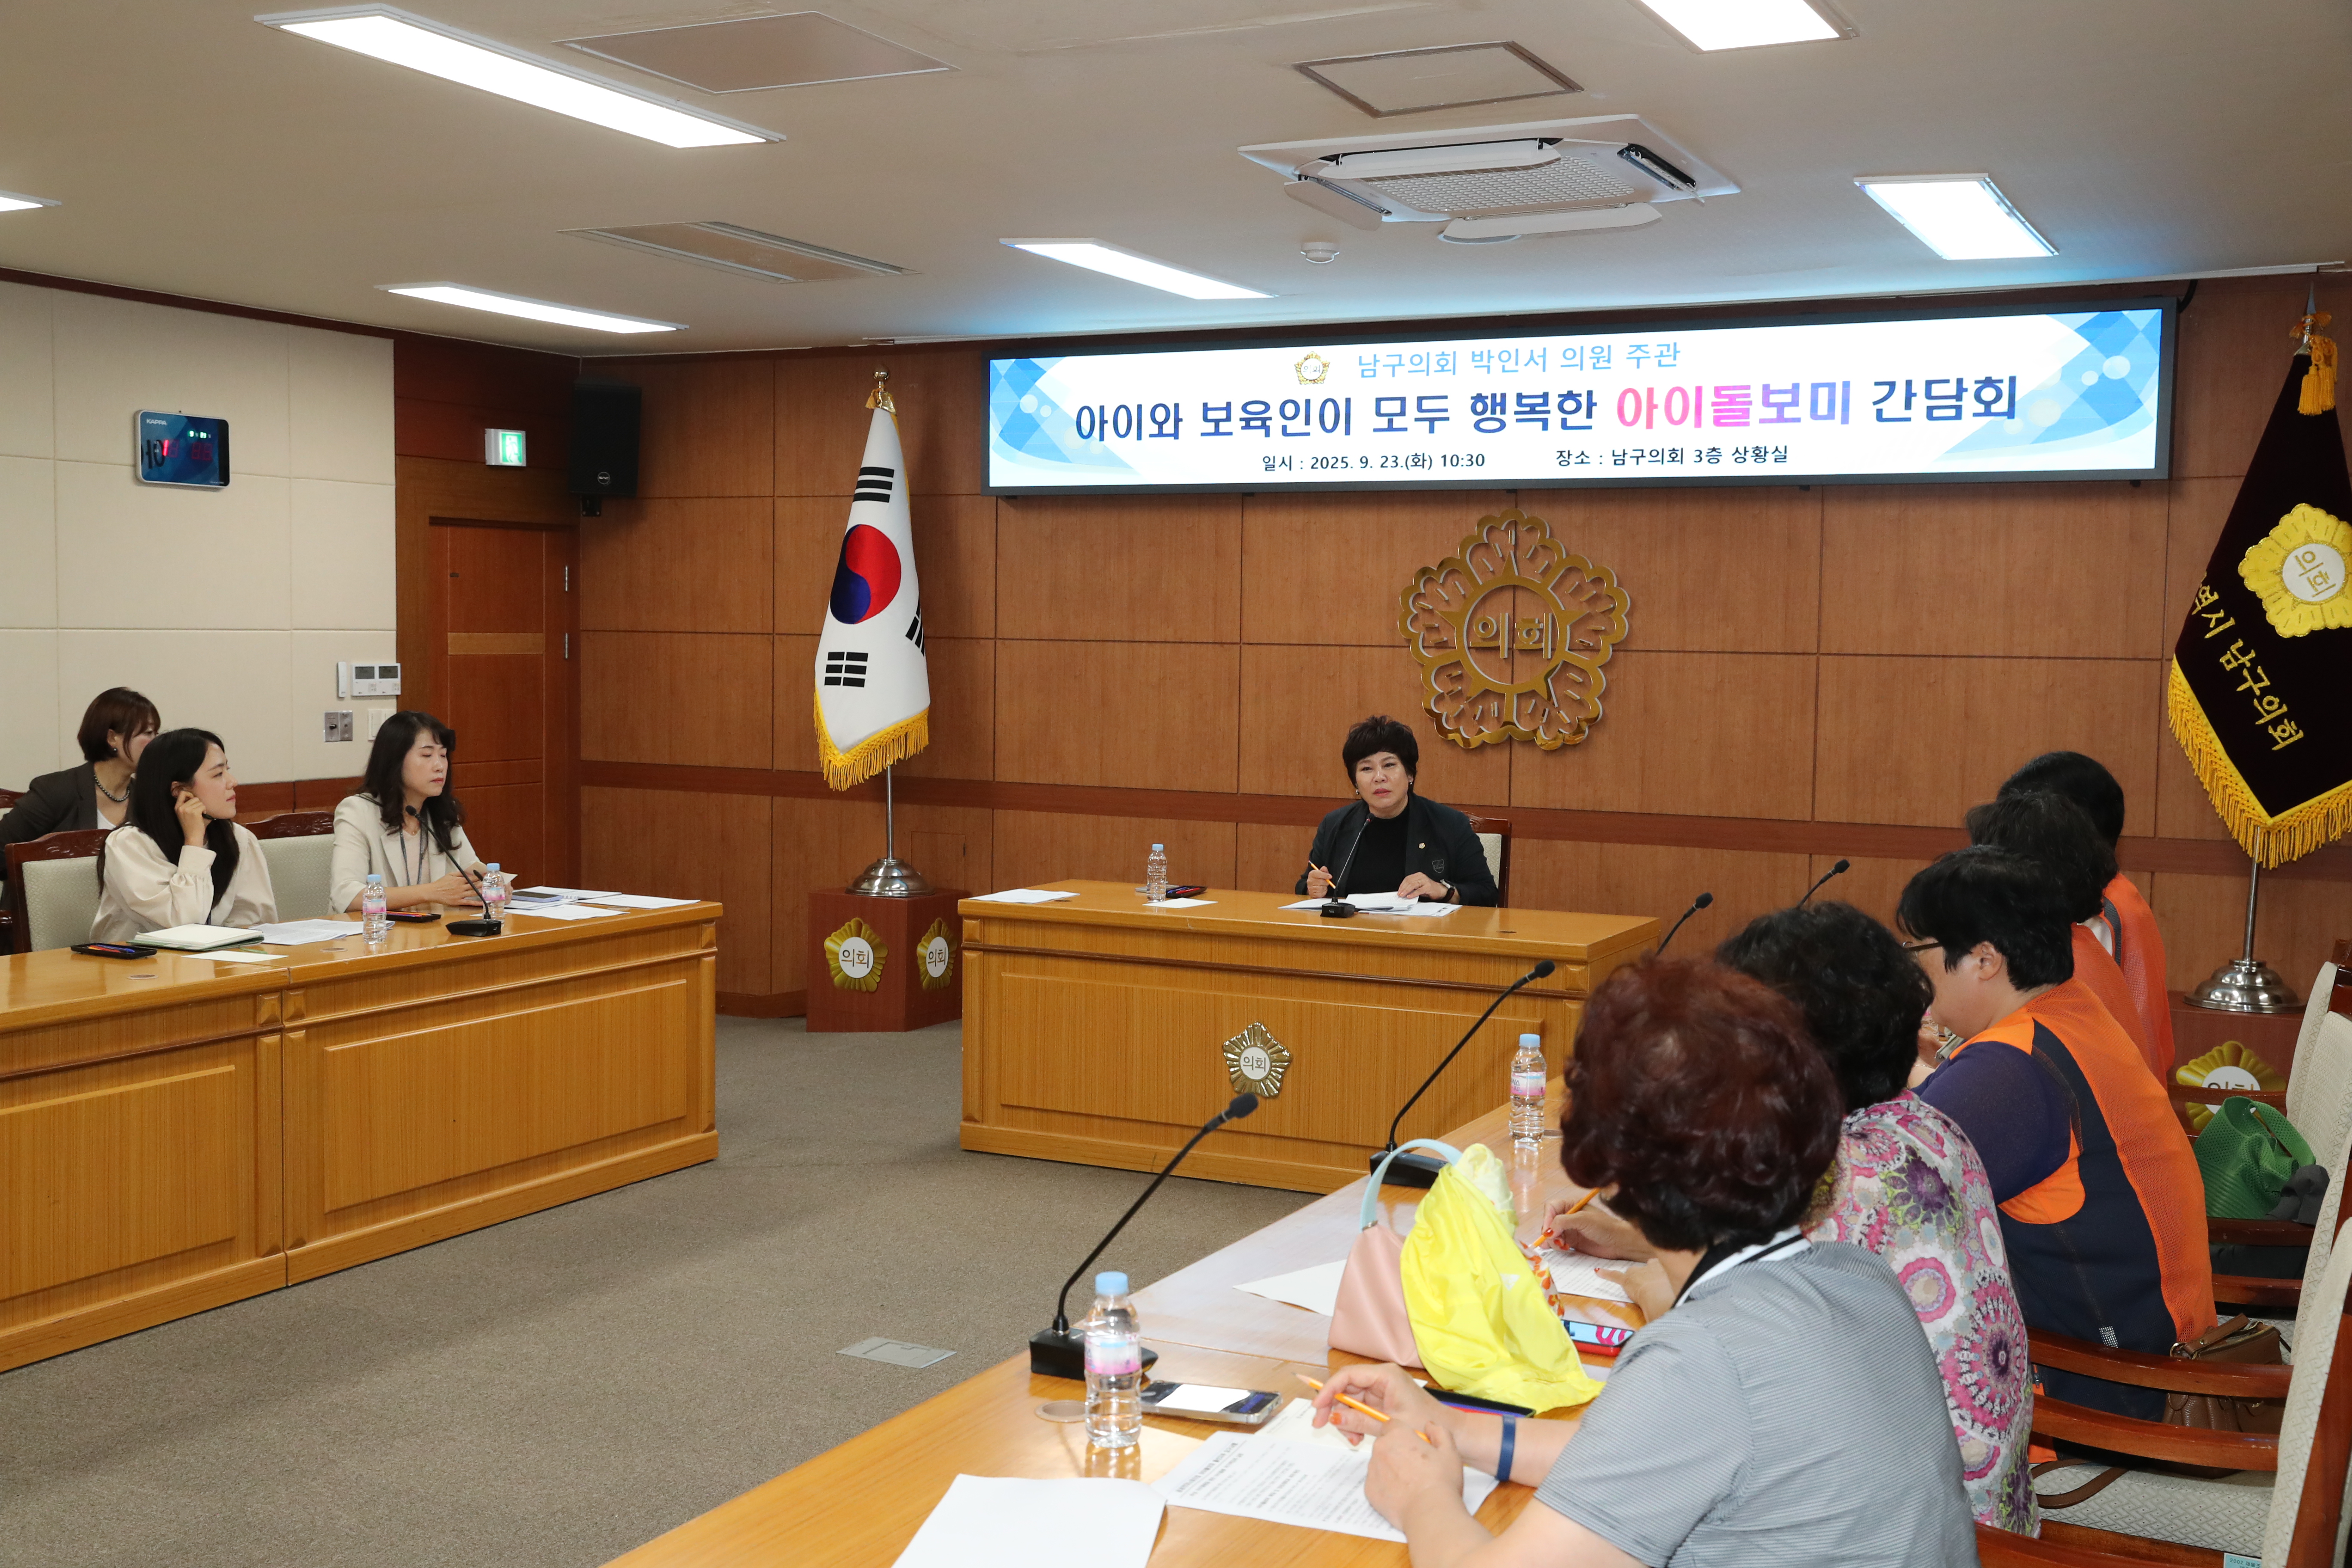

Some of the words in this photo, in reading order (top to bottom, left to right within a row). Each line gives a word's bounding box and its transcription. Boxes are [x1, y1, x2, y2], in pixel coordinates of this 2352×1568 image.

[1359, 351, 1457, 379] 남구의회
[1471, 346, 1547, 375] 박인서
[1560, 344, 1612, 372] 의원
[1626, 342, 1681, 369] 주관
[1075, 402, 1183, 442] 아이와
[1200, 397, 1351, 438] 보육인이
[1372, 395, 1450, 434] 모두
[1470, 389, 1597, 434] 행복한
[1617, 380, 1850, 429] 아이돌보미
[1872, 375, 2017, 423] 간담회
[1262, 455, 1292, 472] 일시
[1311, 456, 1353, 469] 2025.
[1360, 456, 1373, 469] 9.
[1380, 453, 1432, 471] 23.(화)
[1441, 453, 1485, 467] 10:30
[1556, 450, 1590, 467] 장소
[1611, 447, 1684, 466] 남구의회
[1694, 447, 1722, 464] 3층
[1732, 445, 1788, 464] 상황실
[2294, 550, 2336, 597] 의회
[1470, 612, 1553, 659] 의회
[2219, 639, 2304, 751] 남구의회
[841, 948, 869, 968] 의회
[927, 947, 946, 967] 의회
[1243, 1056, 1266, 1072] 의회
